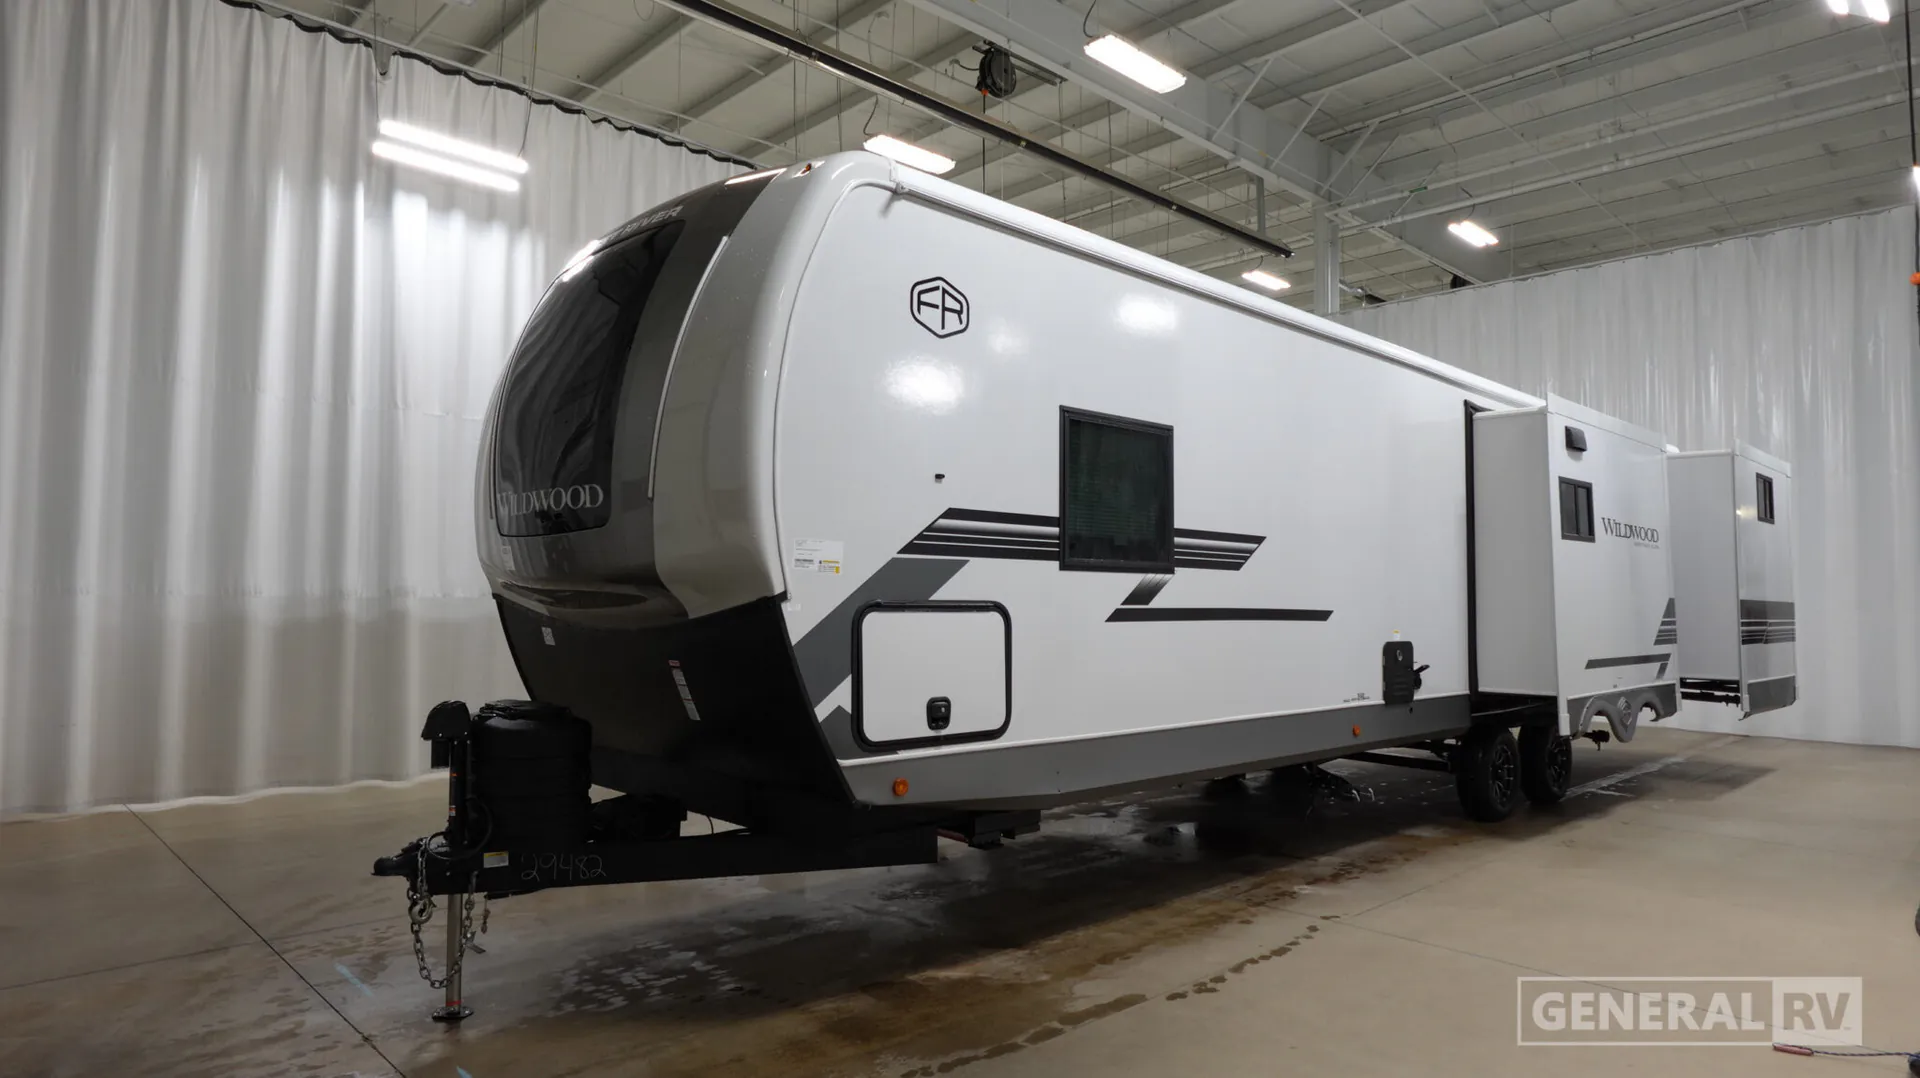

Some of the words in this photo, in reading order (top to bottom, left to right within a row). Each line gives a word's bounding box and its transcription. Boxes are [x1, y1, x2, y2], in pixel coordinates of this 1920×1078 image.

[916, 285, 964, 331] FR
[497, 484, 604, 516] WILDWOOD
[1601, 517, 1660, 543] WILDWOOD
[521, 853, 607, 882] 29482
